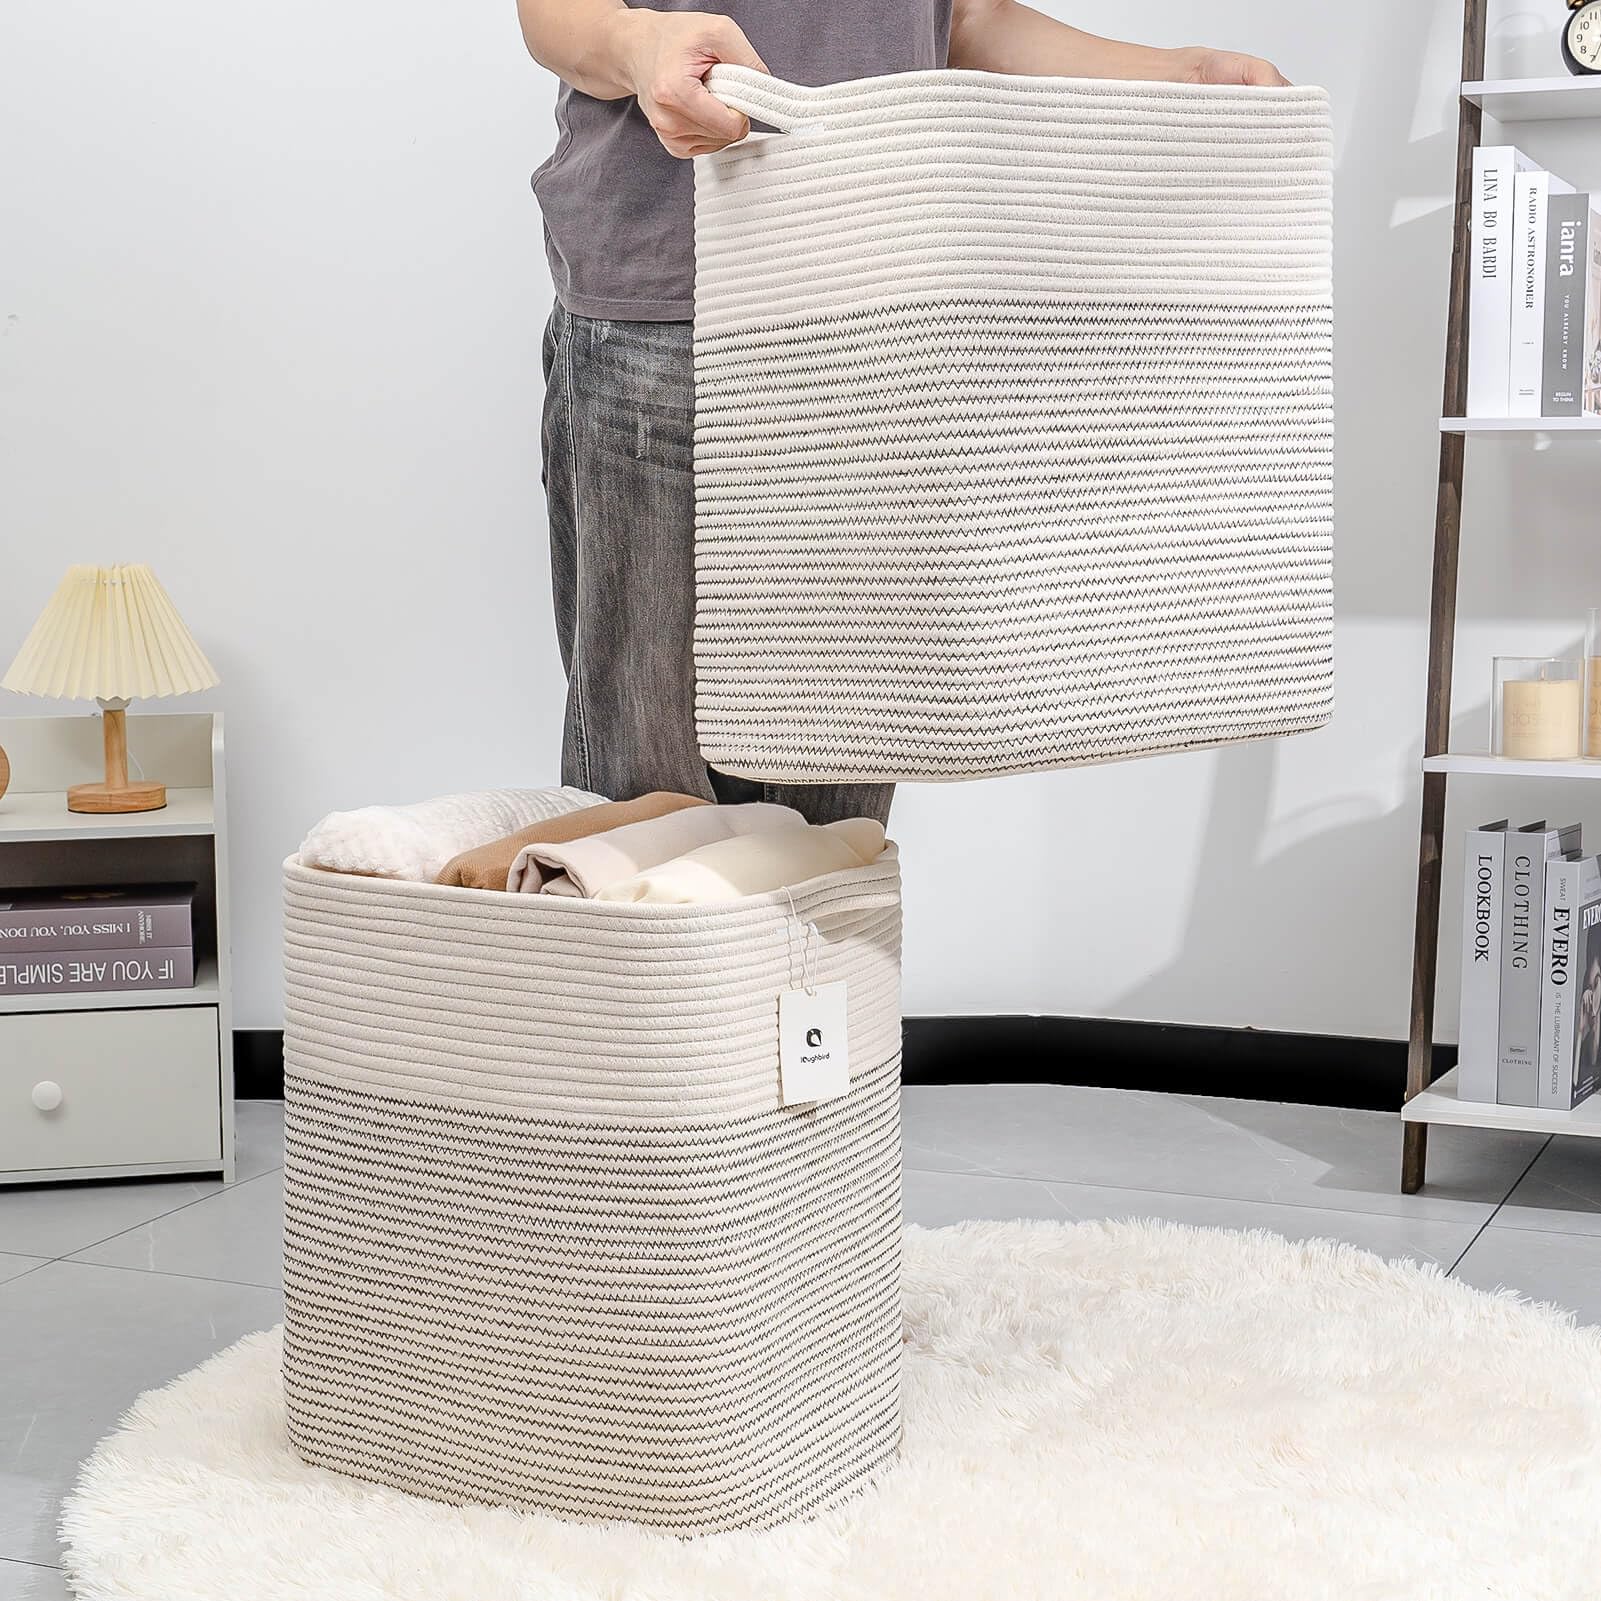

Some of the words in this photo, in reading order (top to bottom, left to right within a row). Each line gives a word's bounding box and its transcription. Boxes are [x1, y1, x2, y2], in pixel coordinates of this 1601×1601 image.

[1579, 21, 1590, 30] 10
[1576, 34, 1583, 43] 9
[1580, 45, 1587, 54] 8
[1483, 168, 1498, 202] LINA
[1528, 187, 1537, 224] RADIO
[1483, 210, 1498, 229] BO
[1482, 237, 1497, 279] BARDI
[1559, 220, 1582, 277] ianra
[1525, 228, 1536, 310] ASTRONOMER
[1559, 877, 1567, 901] SWEAT
[1474, 854, 1493, 963] LOOKBOOK
[1512, 855, 1531, 970] CLOTHING
[30, 926, 57, 938] YOU
[93, 923, 125, 935] MISS
[1550, 907, 1571, 986] EVERO
[69, 962, 107, 983] ARE
[112, 960, 154, 981] YOU
[158, 959, 174, 979] IF
[1502, 1058, 1533, 1066] CLOTHING
[1552, 1054, 1559, 1063] OF
[1551, 1064, 1559, 1095] SUCCESS
